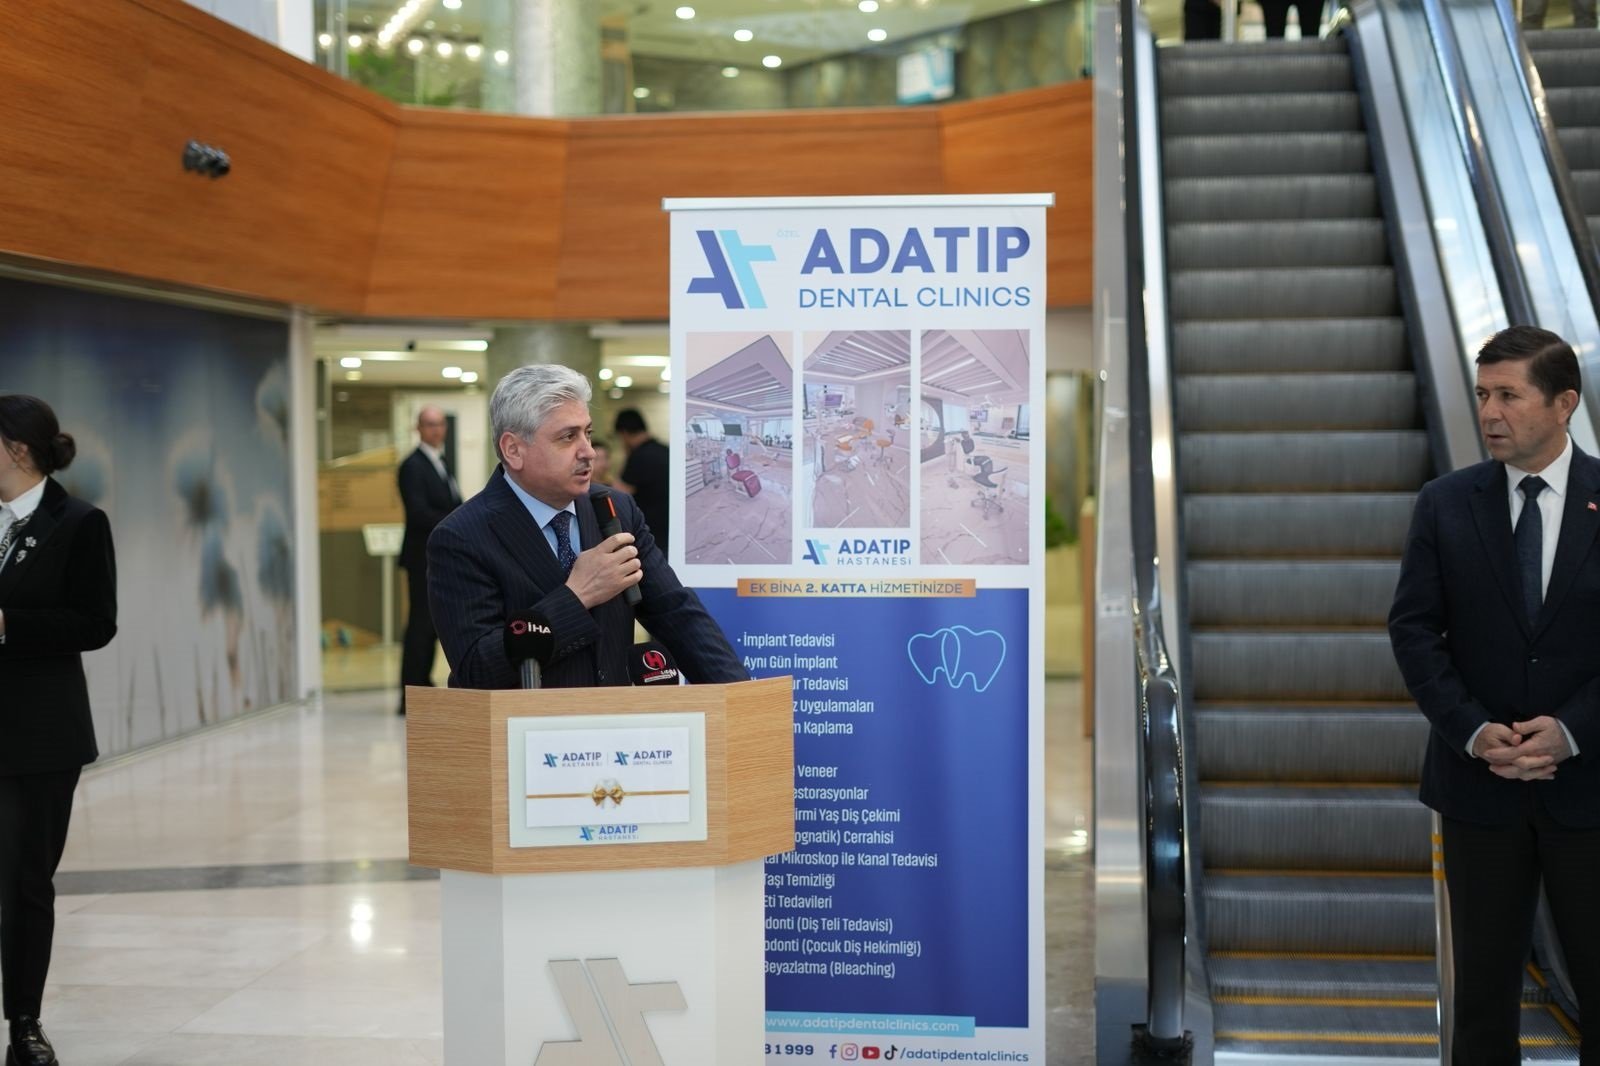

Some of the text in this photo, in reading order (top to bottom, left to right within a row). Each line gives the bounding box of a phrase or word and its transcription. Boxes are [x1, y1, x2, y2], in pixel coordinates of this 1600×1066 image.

[800, 226, 1030, 274] ADATIP
[799, 286, 1030, 308] DENTAL CLINICS
[838, 539, 911, 554] ADATIP
[751, 580, 963, 594] EK BİNA 2. KATTA HİZMETİNİZDE
[743, 632, 835, 648] İmplant Tedavisi
[743, 653, 838, 671] Aynı Gün İmplant
[802, 677, 849, 691] Tedavisi
[800, 699, 874, 715] Uygulamaları
[803, 721, 853, 736] Kaplama
[562, 752, 602, 761] ADATIP
[633, 750, 673, 760] ADATIP
[797, 764, 838, 778] Veneer
[793, 786, 869, 802] estorasyonlar
[795, 807, 901, 824] irmi Yaş Diş Çekimi
[599, 825, 639, 834] ADATIP
[794, 830, 894, 846] ognatik) Cerrahisi
[781, 852, 839, 867] Mikroskop
[841, 852, 855, 865] ile
[857, 853, 889, 866] Kanal
[891, 853, 938, 867] Tedavisi
[786, 872, 836, 889] Temizliği
[777, 894, 833, 909] Tedavileri
[765, 916, 893, 934] donti (Diş Teli Tedavisi)
[764, 938, 921, 957] odonti (Çocuk Diş Hekimliği)
[829, 960, 896, 979] (Bleaching)
[765, 1016, 960, 1032] www.adatipdentalclinics.com
